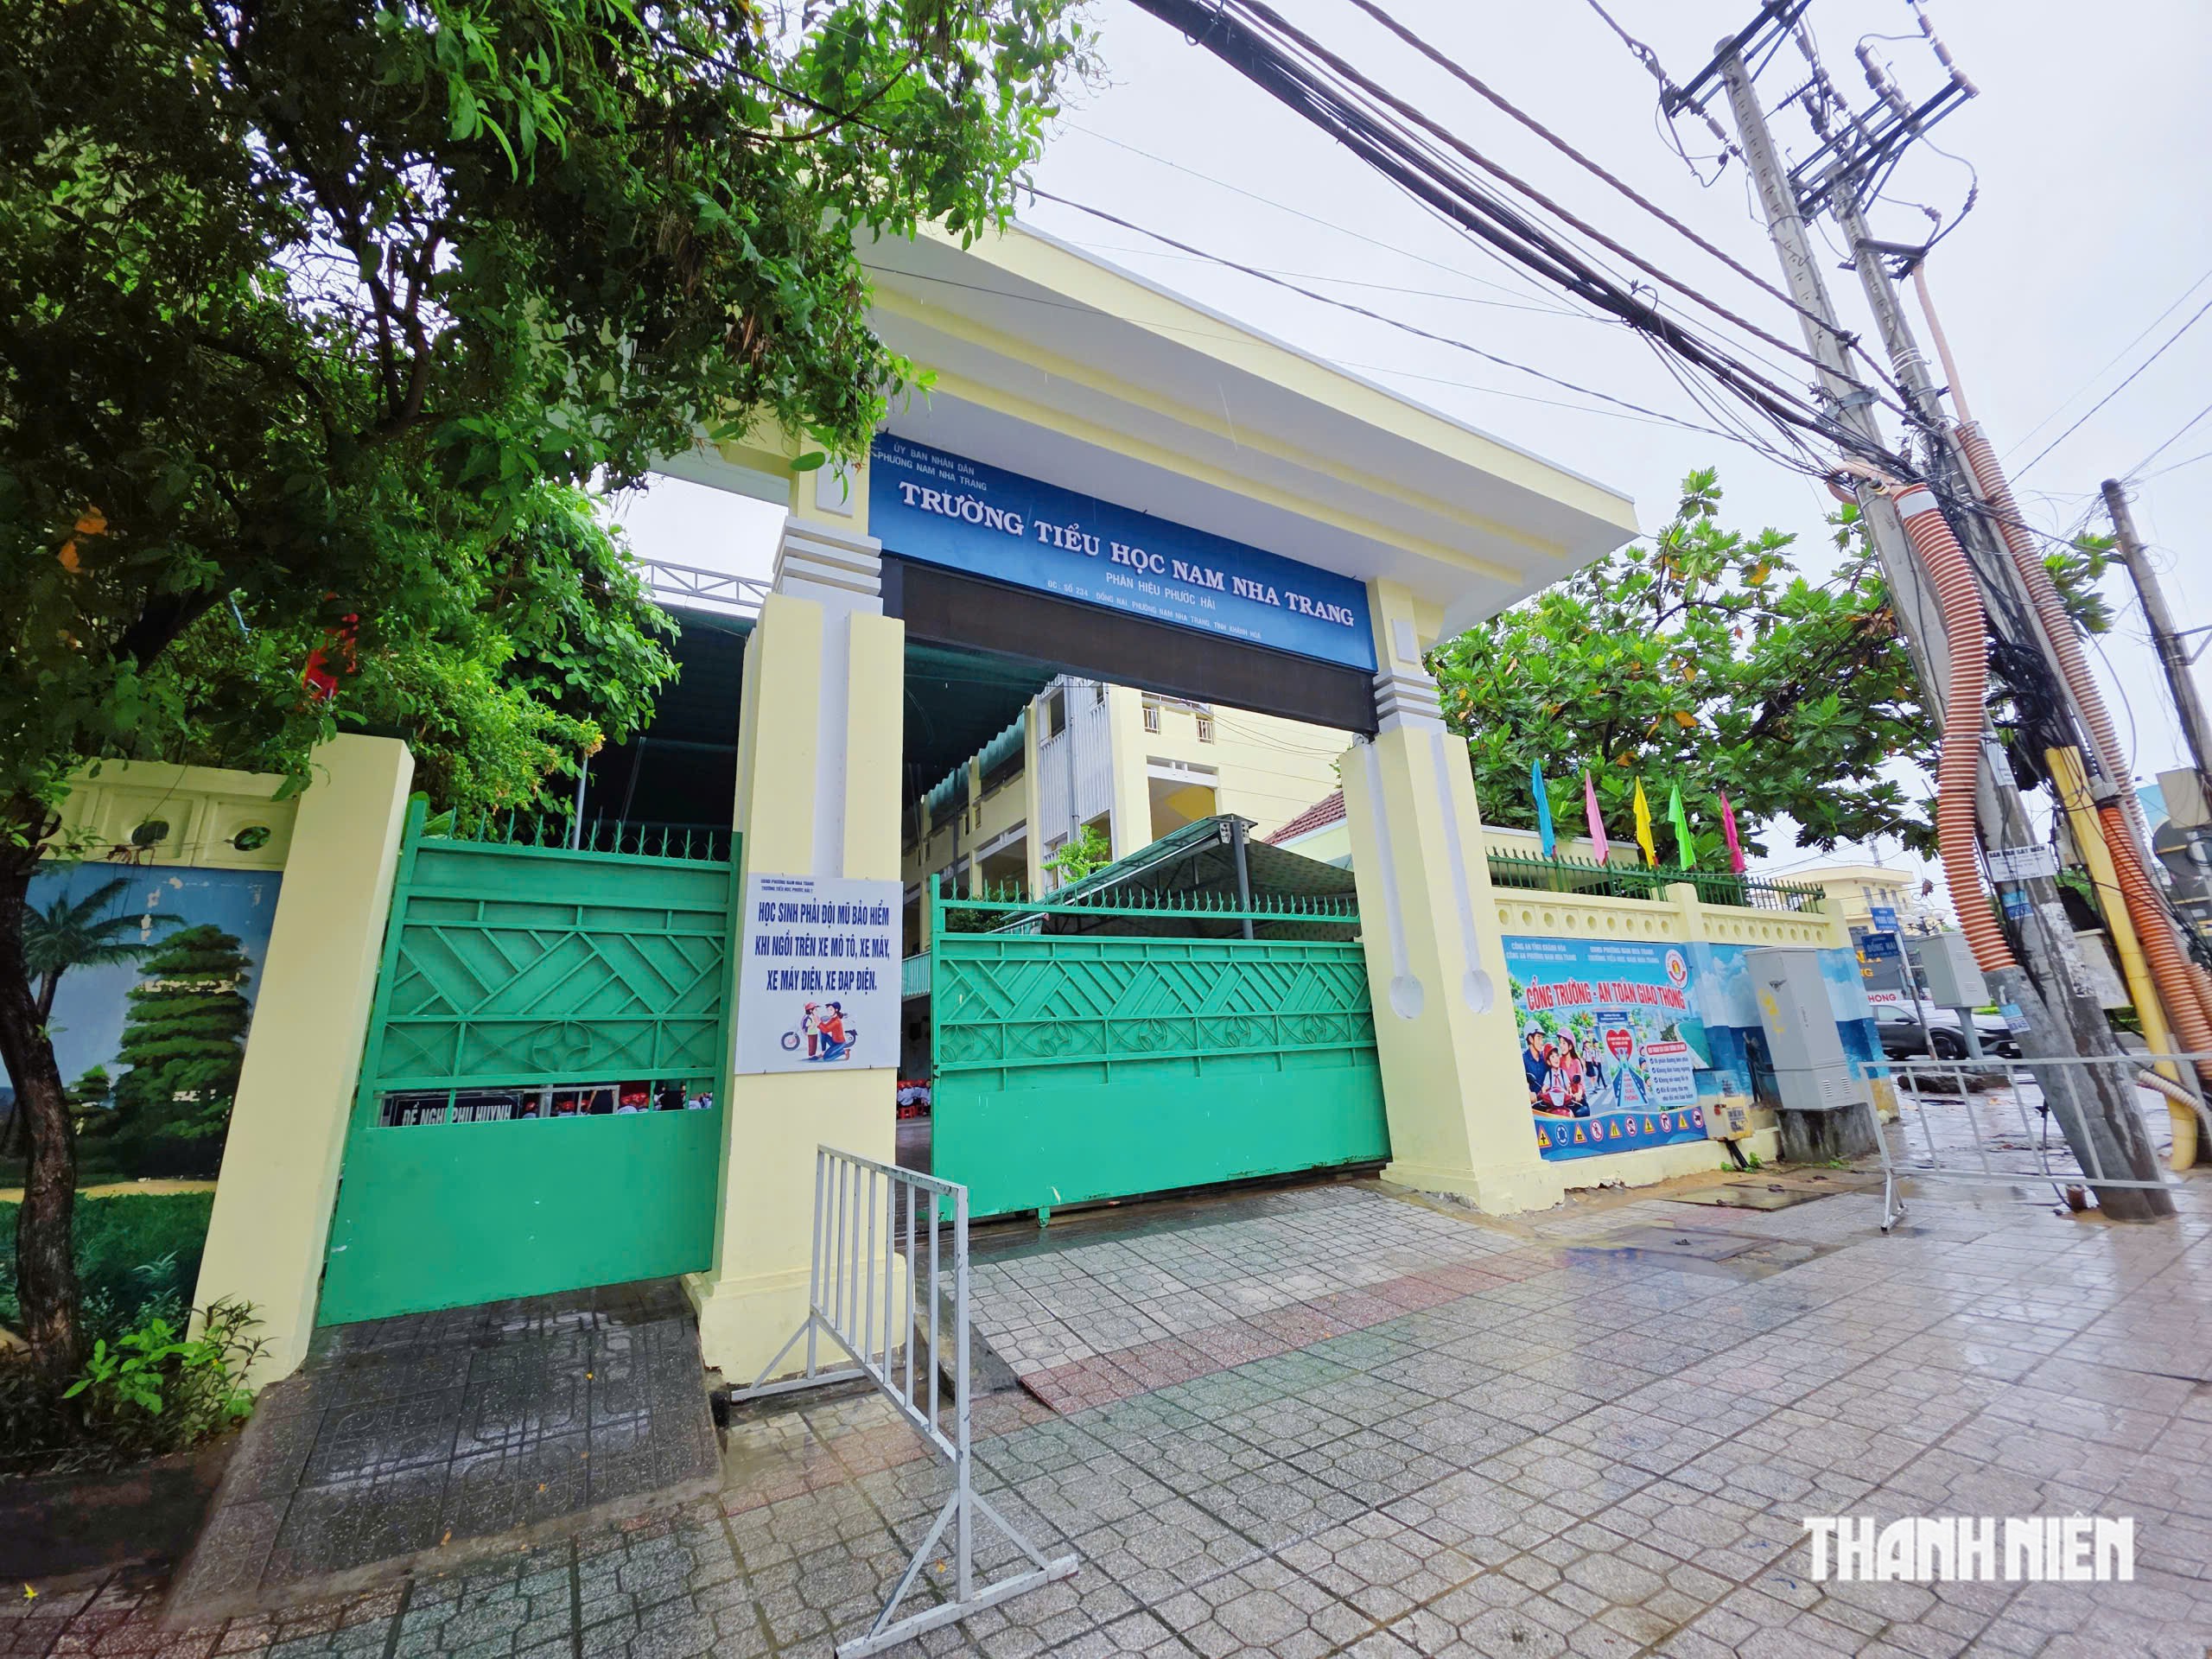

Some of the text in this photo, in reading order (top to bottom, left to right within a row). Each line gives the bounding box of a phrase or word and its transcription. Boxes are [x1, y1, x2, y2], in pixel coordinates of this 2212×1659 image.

[910, 449, 927, 461] BAN
[931, 455, 954, 469] NHÂN
[957, 462, 975, 475] DÂN
[916, 462, 935, 475] NAM
[939, 470, 956, 481] NHA
[960, 476, 987, 491] TRANG
[899, 480, 1355, 626] TRƯỜNG TIỂU HỌC NAM NHA TRANG
[1106, 572, 1134, 588] PHÂN
[1139, 581, 1160, 596] HIỆU
[1165, 588, 1195, 605] PHƯỚC
[1159, 607, 1173, 618] NAM
[1175, 612, 1188, 621] NHA
[758, 898, 889, 929] HỌC SINH PHẢI ĐỘI MŨ BẢO HIỂM
[755, 935, 770, 956] KHI
[795, 932, 816, 957] TRÊN
[818, 937, 829, 957] XE
[830, 933, 843, 957] MÔ
[846, 933, 857, 961] TÔ,
[860, 938, 869, 957] XE
[872, 934, 890, 961] MÁY,
[766, 966, 877, 995] XE MÁY ĐIỆN, XE ĐẠP ĐIỆN.
[1526, 976, 1554, 1011] CỔNG
[1554, 977, 1592, 1007] TRƯỜNG
[1598, 982, 1612, 1003] AN
[1611, 977, 1637, 1003] TOÀN
[1637, 983, 1658, 1005] GIAO
[1657, 983, 1686, 1009] THÔNG
